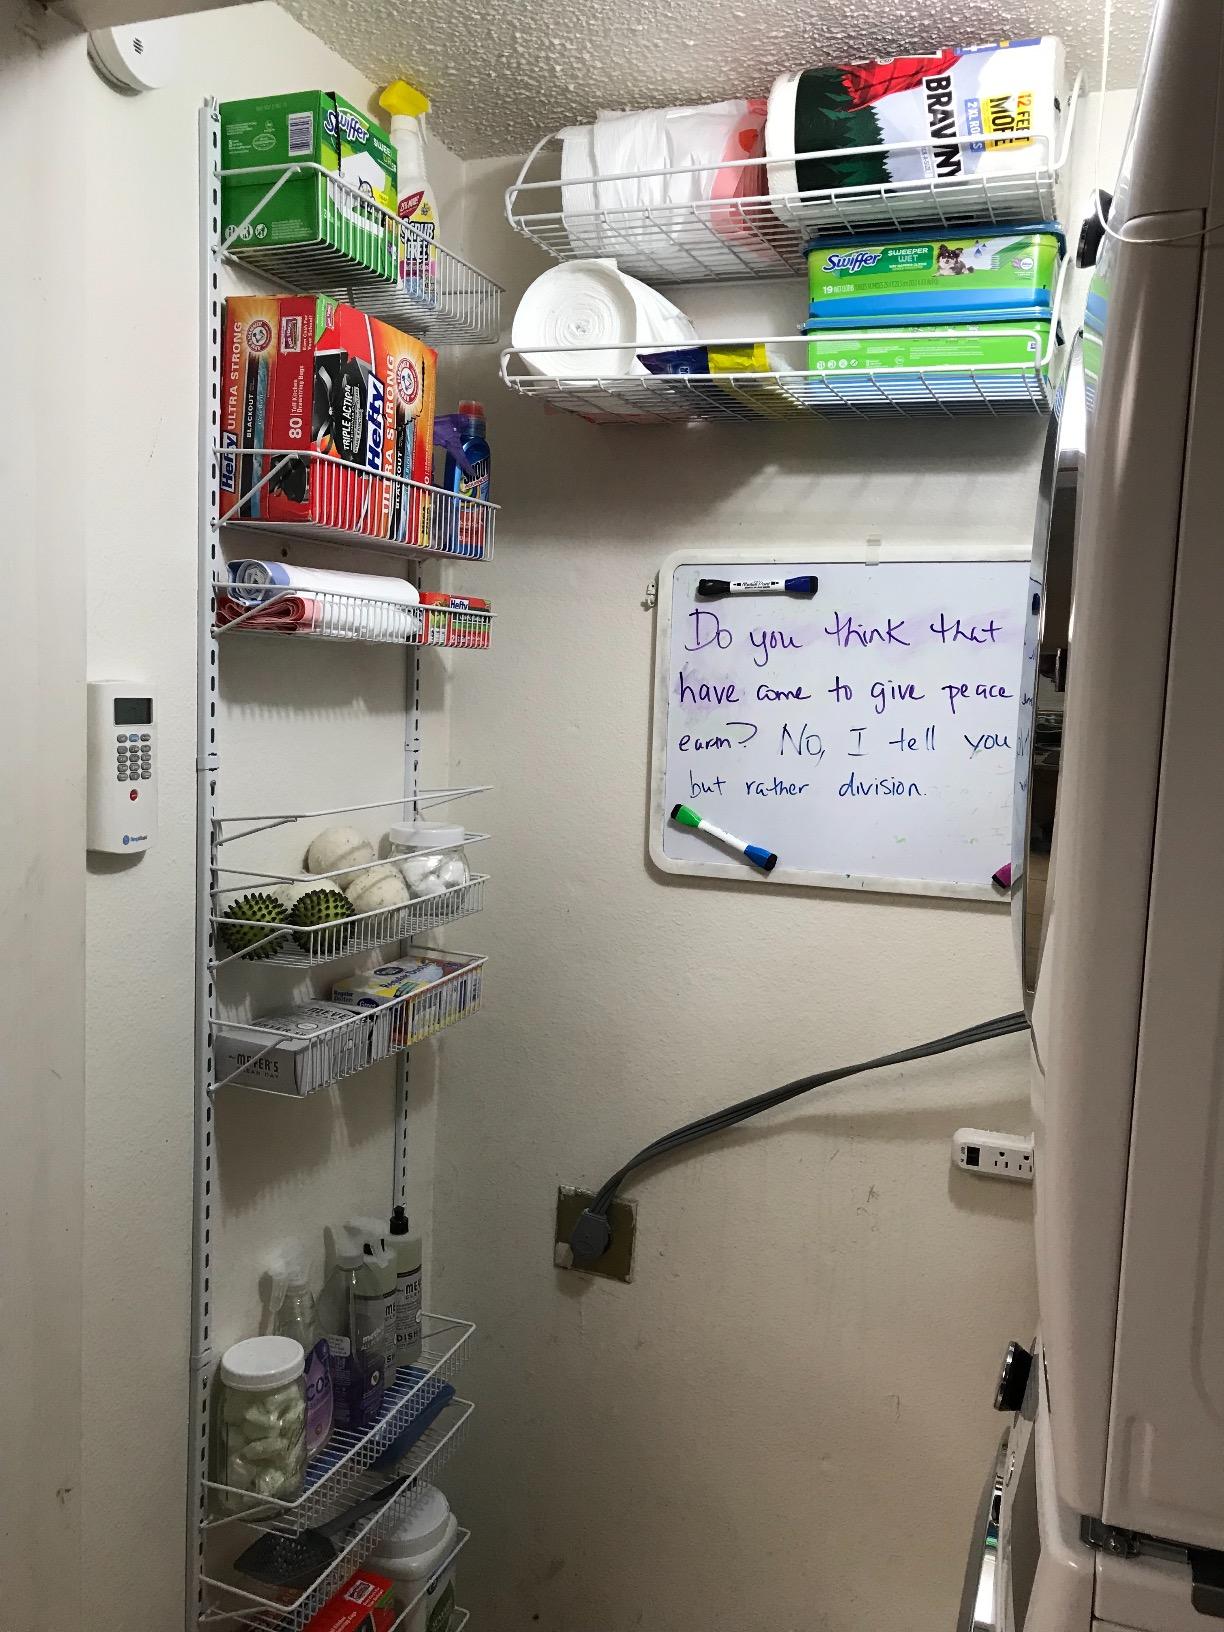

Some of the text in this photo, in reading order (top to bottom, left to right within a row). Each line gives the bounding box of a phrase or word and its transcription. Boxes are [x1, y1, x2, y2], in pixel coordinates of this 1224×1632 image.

[969, 109, 979, 121] XL
[1018, 92, 1032, 108] 12
[323, 109, 370, 144] Swiffer
[926, 76, 962, 178] BRAWNY
[970, 120, 983, 150] ROS
[822, 249, 882, 273] Swiffer
[887, 247, 929, 257] SWEEPER
[897, 254, 919, 263] WET
[822, 285, 833, 294] 19
[227, 321, 241, 430] ULTRA STRONG
[386, 354, 395, 440] STRONG
[246, 393, 254, 438] BLACKOUT
[288, 417, 303, 439] 80
[342, 384, 353, 451] TRIPLE ACTION
[367, 381, 384, 471] Hefty
[222, 434, 237, 490] Hefty
[450, 599, 469, 611] Hefty
[685, 608, 1003, 667] Do you think that
[679, 671, 1014, 715] have come to give peace
[780, 722, 826, 768] No,
[847, 727, 869, 757] I
[889, 724, 936, 752] tell
[963, 733, 1012, 760] you
[689, 769, 927, 799] but rather division.
